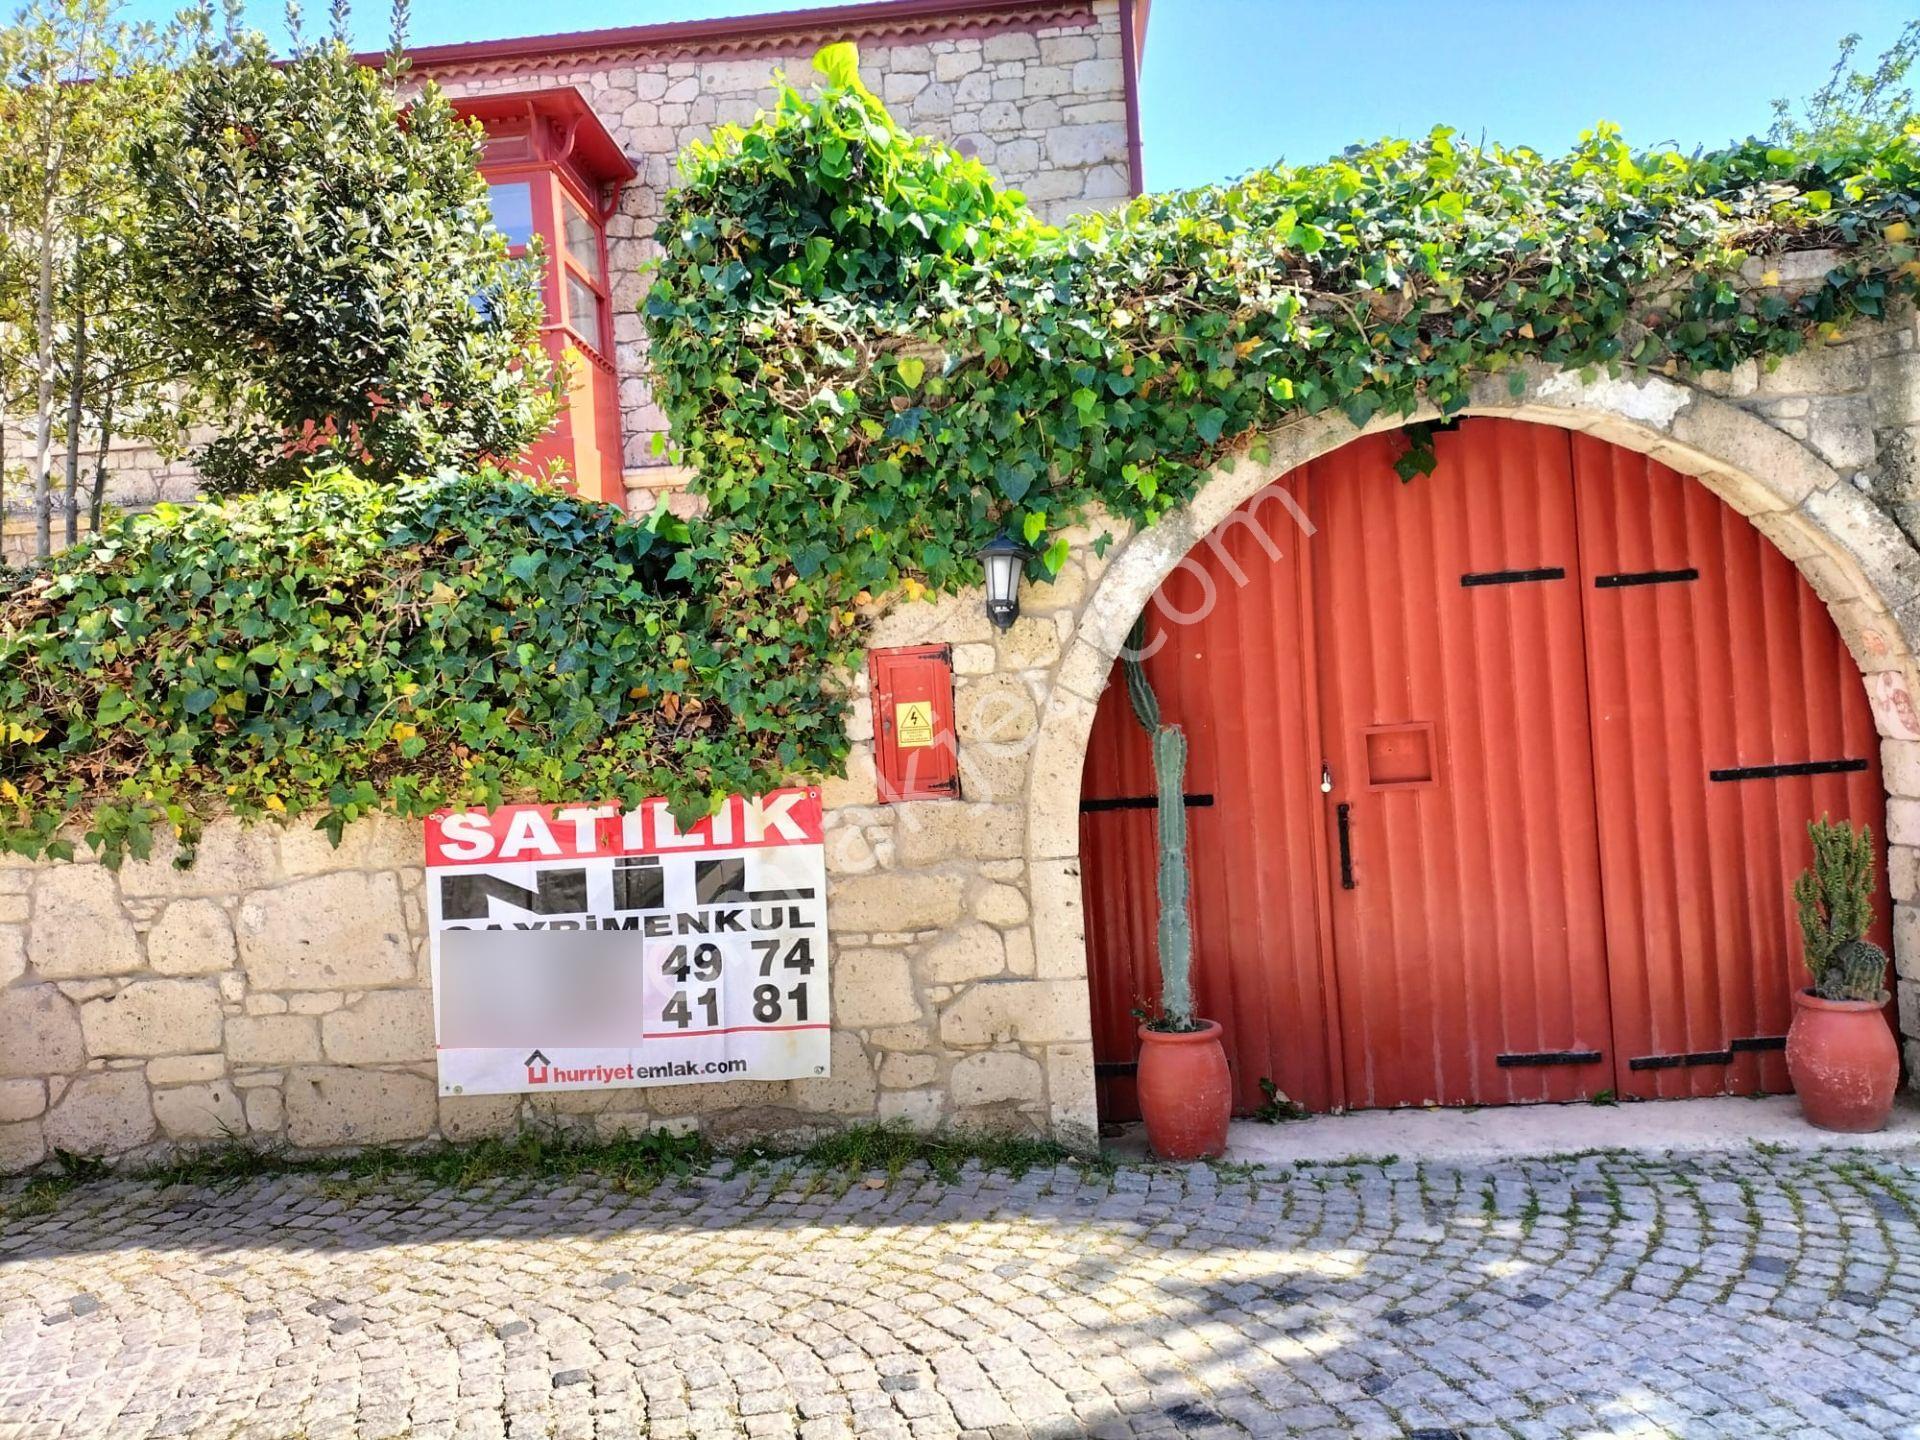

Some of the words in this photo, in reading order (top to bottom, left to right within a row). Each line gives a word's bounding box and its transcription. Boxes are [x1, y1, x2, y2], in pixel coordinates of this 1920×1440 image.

[439, 792, 810, 861] SATILIK
[440, 855, 816, 920] NİL
[444, 906, 816, 937] İMENKUL
[661, 942, 723, 983] 49
[750, 937, 815, 977] 74
[661, 987, 720, 1029] 41
[752, 982, 808, 1023] 81
